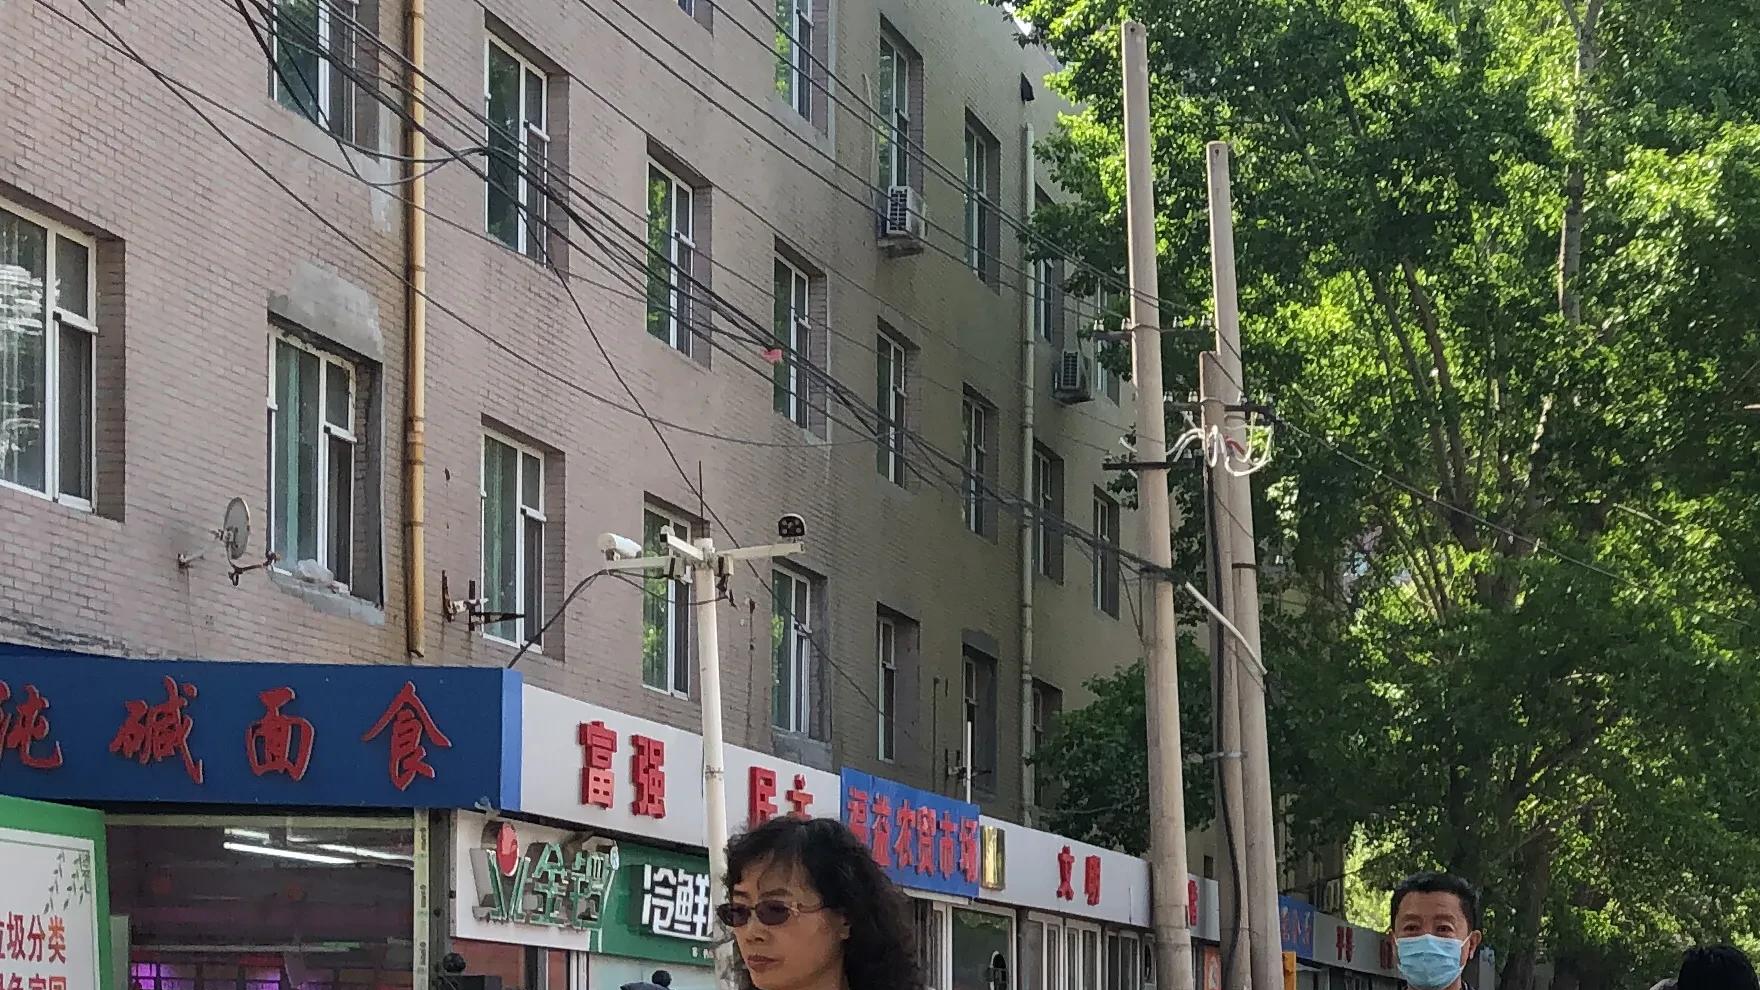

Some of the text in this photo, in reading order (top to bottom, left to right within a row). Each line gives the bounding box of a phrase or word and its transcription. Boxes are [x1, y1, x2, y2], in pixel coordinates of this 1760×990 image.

[578, 721, 814, 828] 富强 民主
[641, 864, 713, 941] 冷鲜
